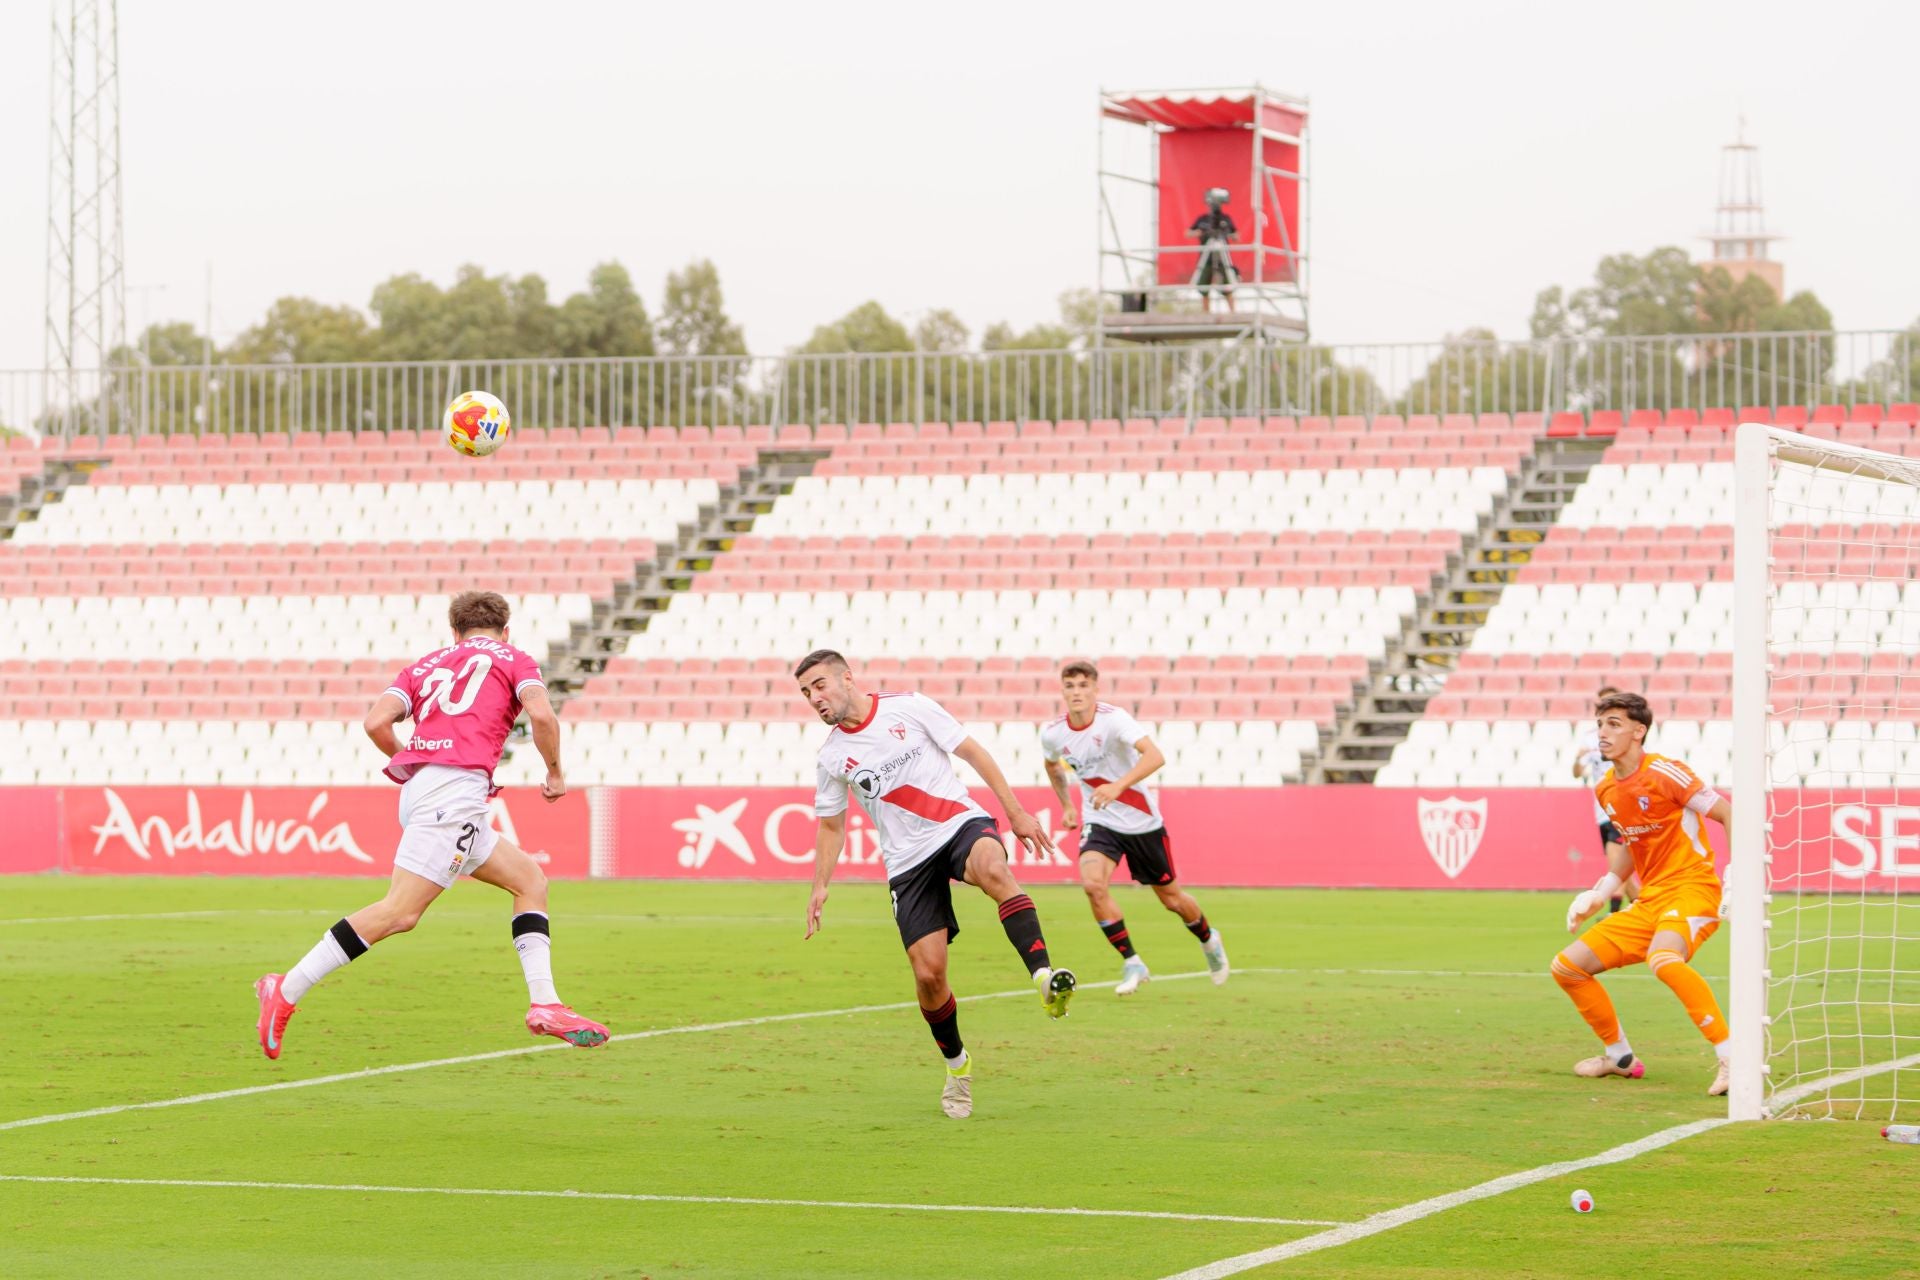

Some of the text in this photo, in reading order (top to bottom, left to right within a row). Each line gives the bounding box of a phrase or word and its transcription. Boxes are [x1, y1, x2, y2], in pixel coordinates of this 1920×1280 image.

[412, 644, 460, 676] DIEGO
[419, 653, 493, 720] 20
[407, 736, 453, 751] ribera
[880, 746, 921, 776] SEVILLA FC
[90, 787, 375, 860] Andalucía
